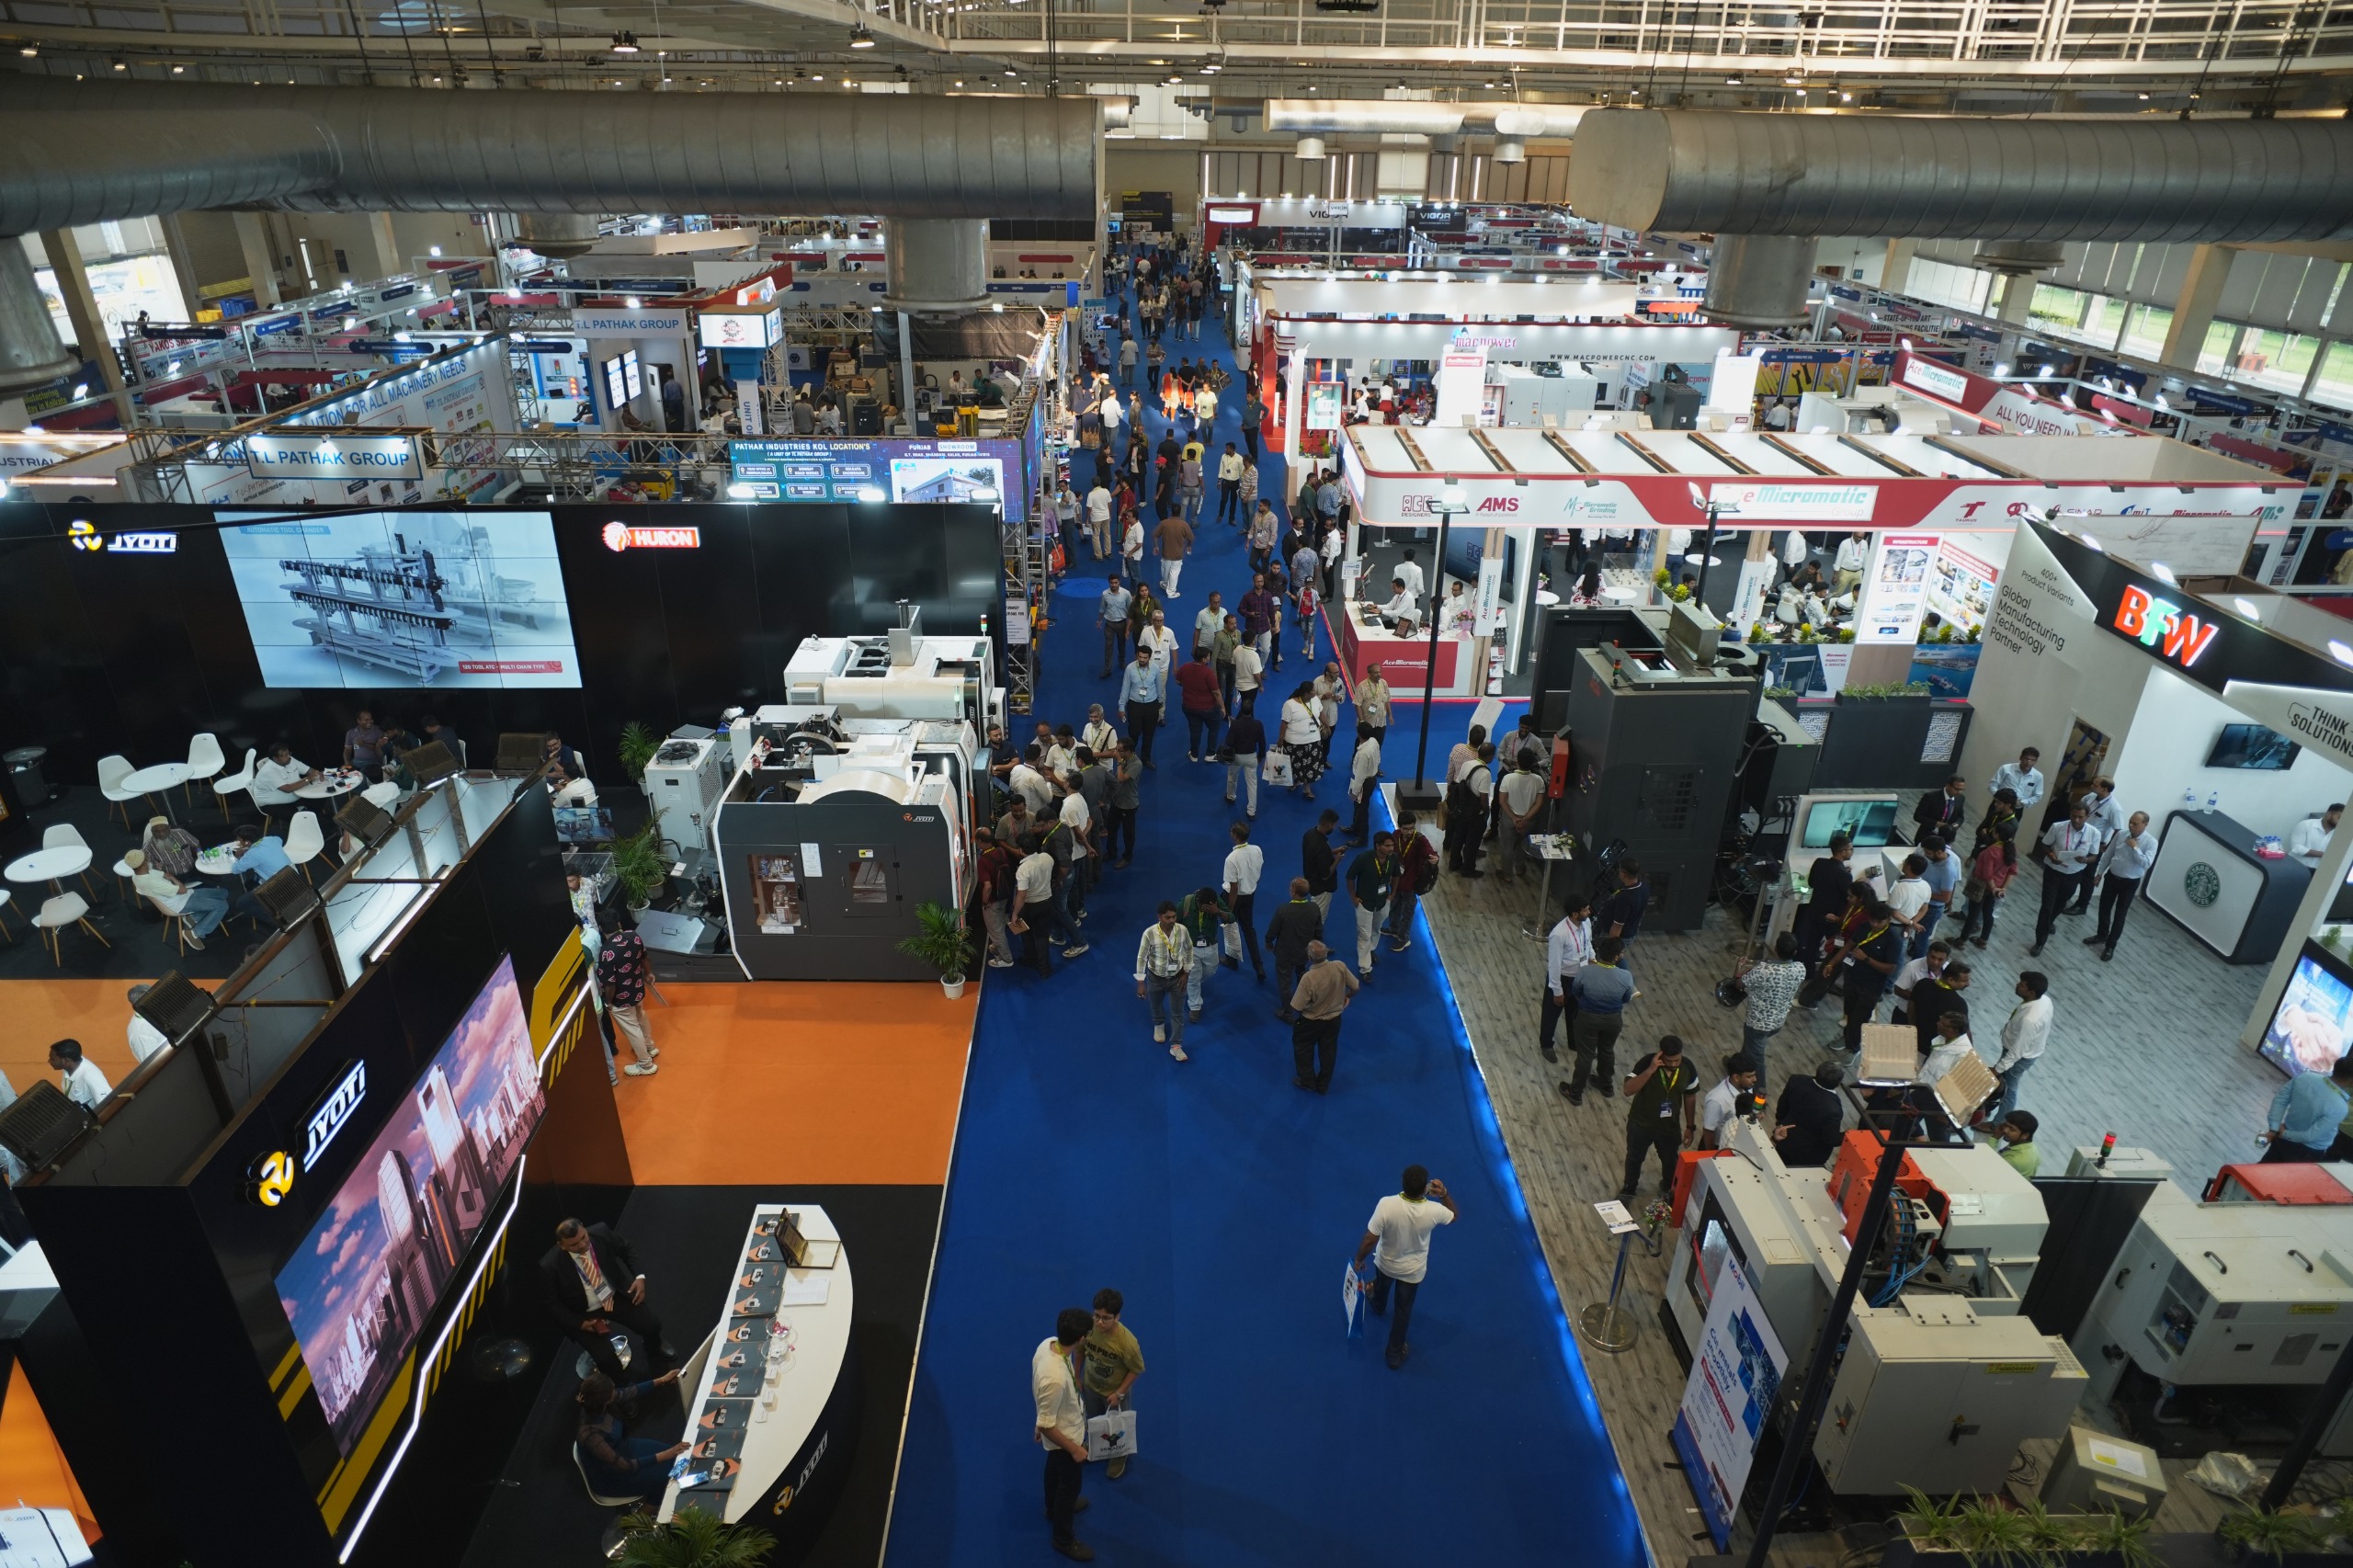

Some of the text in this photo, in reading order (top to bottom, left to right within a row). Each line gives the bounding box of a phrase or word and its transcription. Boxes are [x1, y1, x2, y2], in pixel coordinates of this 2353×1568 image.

[593, 320, 637, 329] PATHAK
[640, 320, 679, 329] GROUP
[369, 395, 388, 412] ALL
[388, 370, 439, 406] MACHINERY
[440, 359, 467, 381] NEEDS
[1906, 361, 1962, 389] Ace Micromatic
[744, 401, 753, 423] UNIT
[1996, 405, 2012, 422] ALL
[2016, 410, 2035, 428] YOU
[2035, 419, 2062, 437] NEED
[251, 450, 410, 466] T.L PATHAK GROUP
[1476, 497, 1519, 512] AMS
[1757, 486, 1867, 504] Micromatic
[1831, 507, 1864, 517] Group
[108, 534, 176, 552] JYOTI
[636, 530, 694, 546] HURON
[2021, 570, 2075, 607] Product Variants
[2040, 568, 2058, 583] 400+
[2002, 585, 2031, 610] Global
[1995, 612, 2046, 656] Technology
[1998, 599, 2065, 653] Manufacturing
[2114, 585, 2220, 667] BFW
[1990, 627, 2022, 654] Partner
[2313, 707, 2349, 735] THINK
[2189, 865, 2218, 891] STARBUCKS
[2188, 887, 2210, 904] COFFEE
[303, 1061, 366, 1173] JYOTI
[1728, 1259, 1745, 1291] Mobil
[1710, 1327, 1720, 1350] Cut
[1718, 1349, 1737, 1388] metals
[795, 1430, 828, 1497] JYOTI
